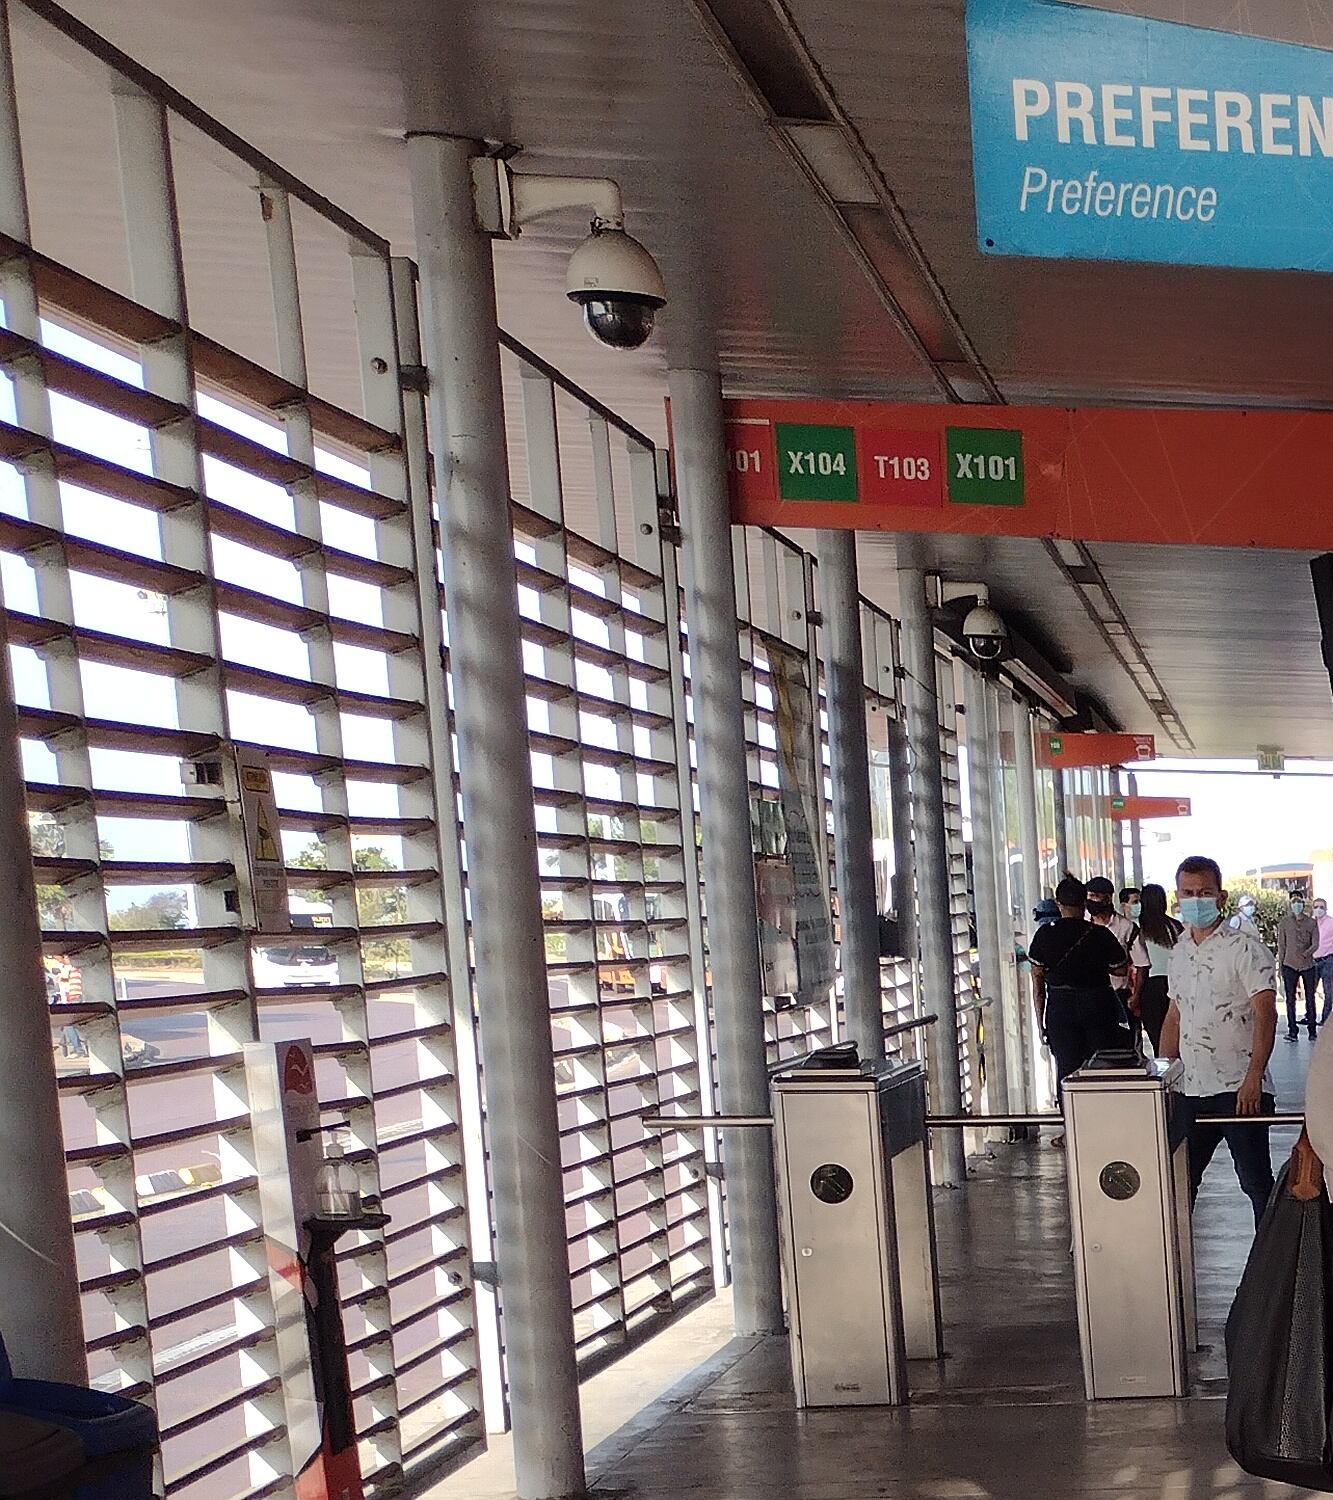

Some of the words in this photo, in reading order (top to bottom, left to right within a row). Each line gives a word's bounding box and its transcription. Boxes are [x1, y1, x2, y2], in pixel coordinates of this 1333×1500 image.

[1019, 165, 1218, 223] Preference
[735, 449, 761, 473] 01
[787, 450, 846, 475] X104
[874, 455, 930, 480] T103
[956, 453, 1016, 480] X101
